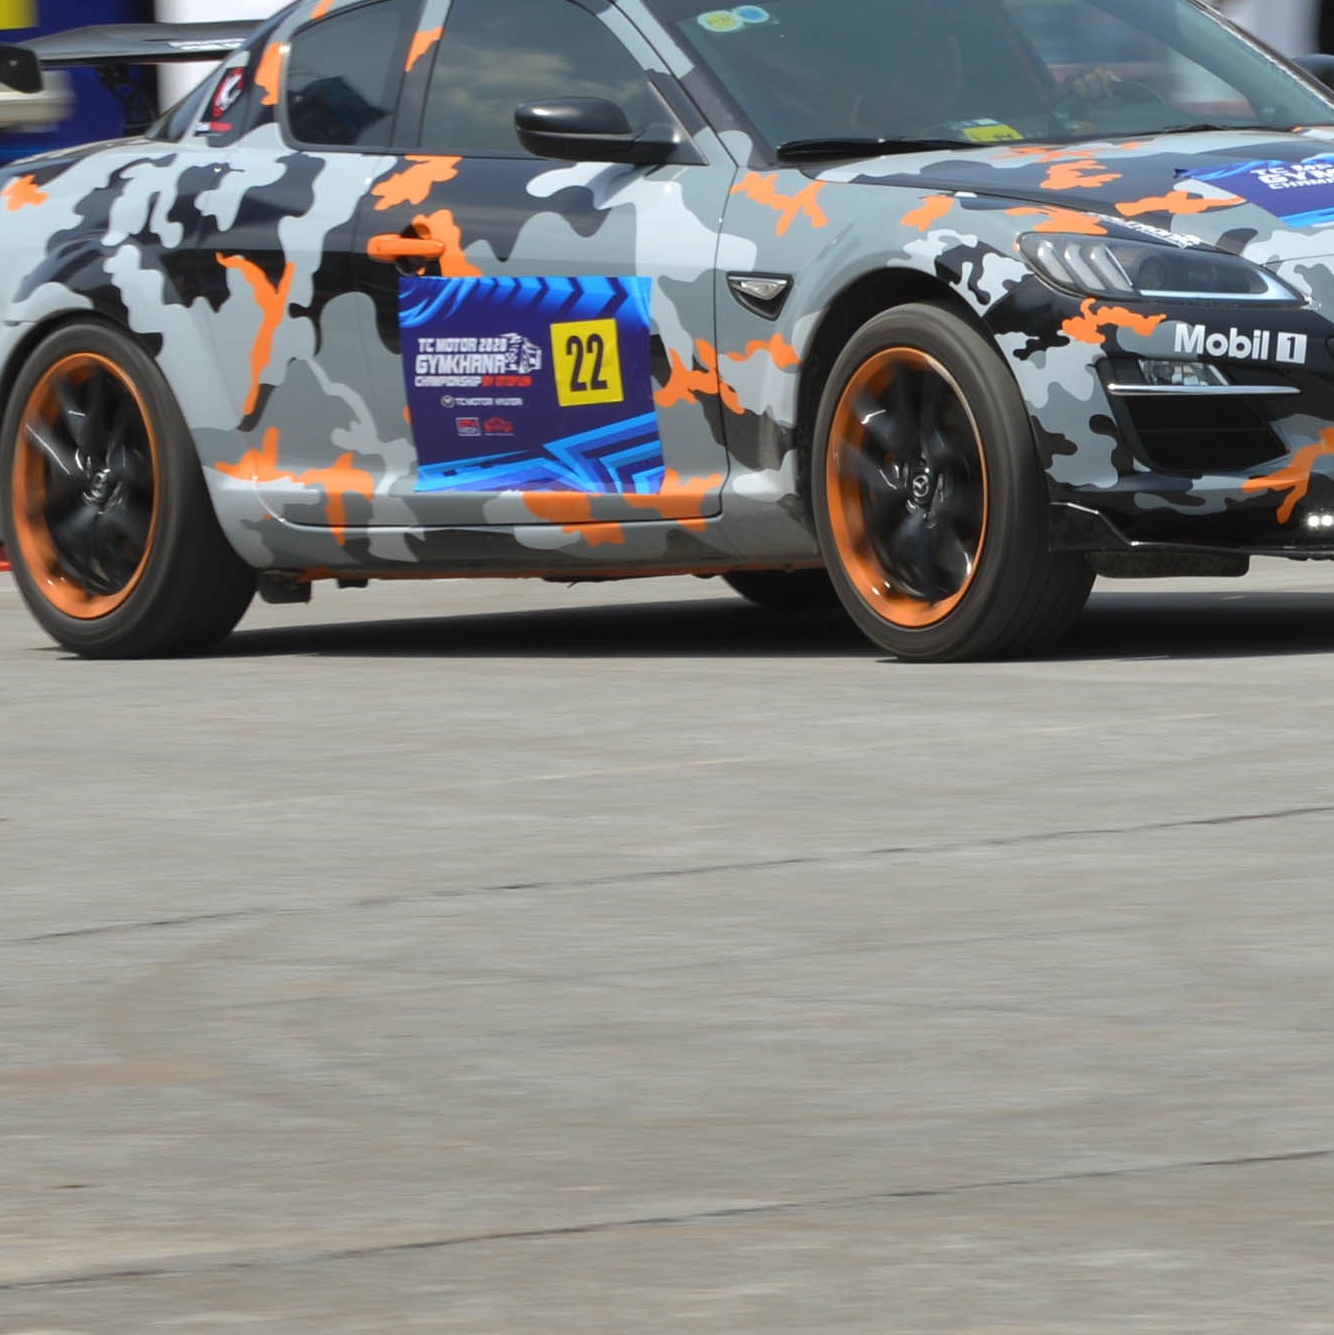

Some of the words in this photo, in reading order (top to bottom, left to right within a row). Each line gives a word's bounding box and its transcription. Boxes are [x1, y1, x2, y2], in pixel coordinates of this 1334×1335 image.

[417, 338, 435, 353] TC
[435, 337, 478, 353] MOTOR
[478, 337, 508, 353] 2020
[1174, 322, 1271, 361] Mobil
[415, 353, 506, 374] GYMKHANA
[565, 333, 609, 393] 22
